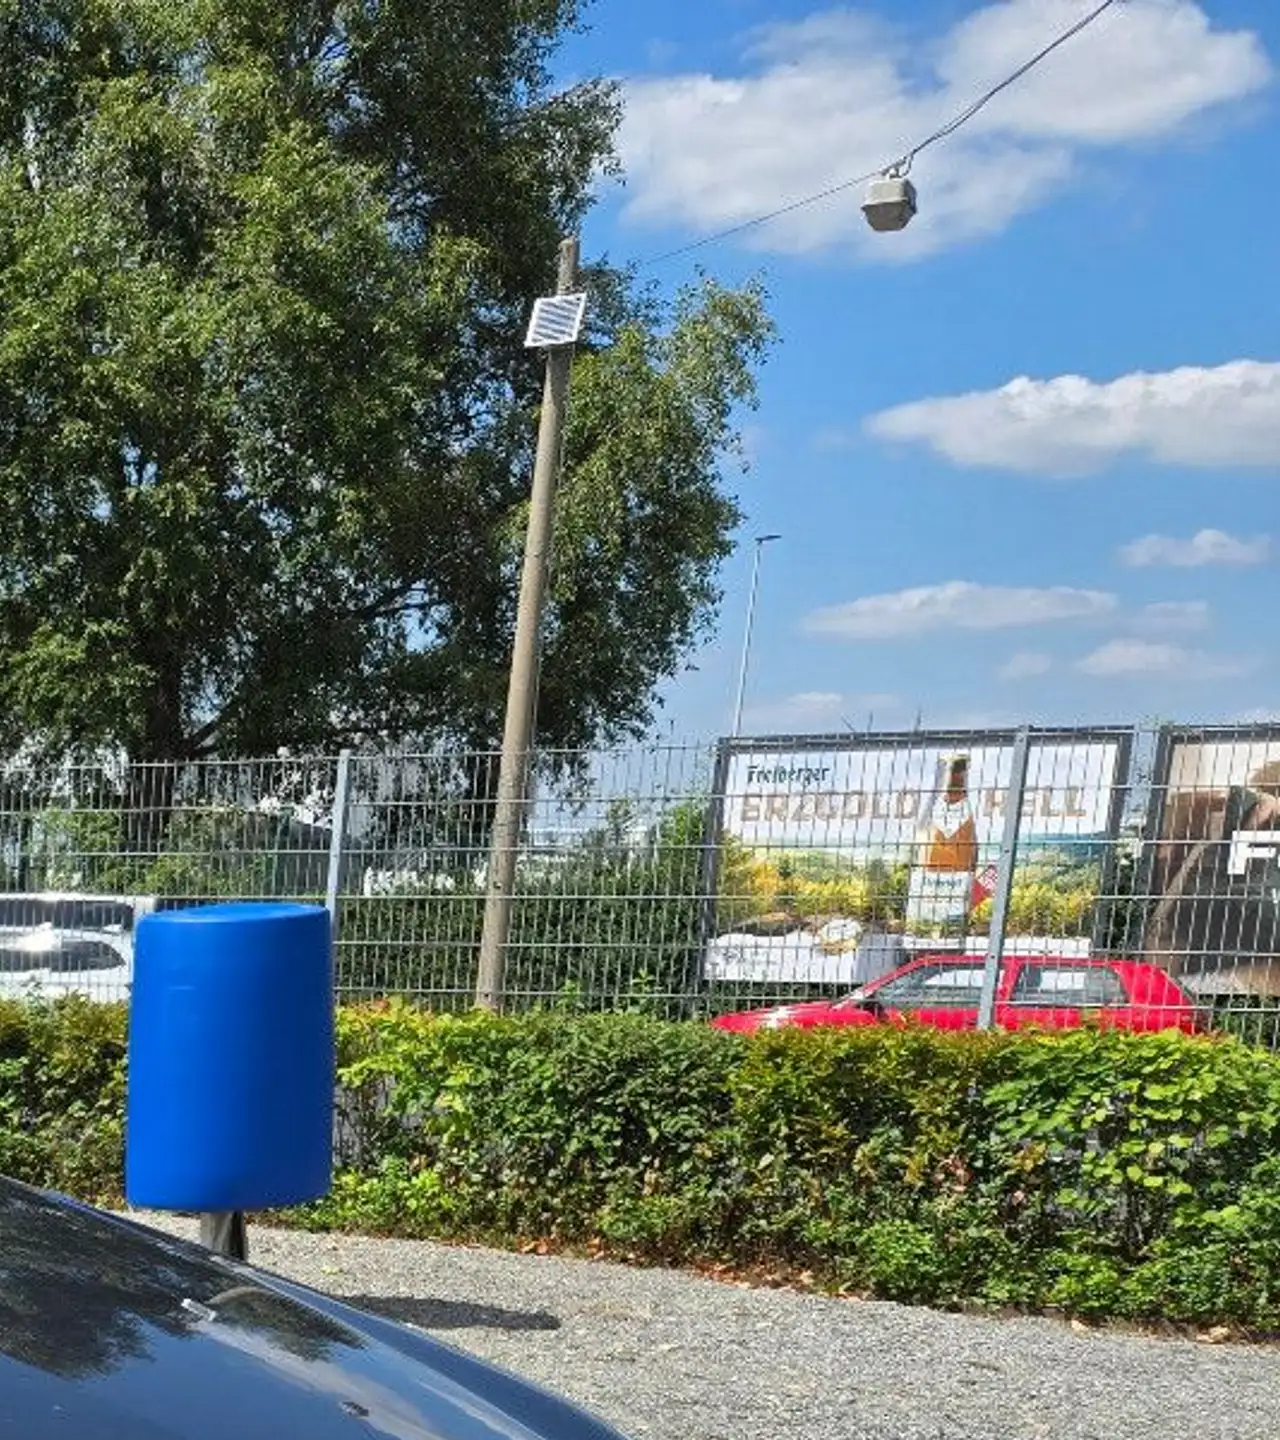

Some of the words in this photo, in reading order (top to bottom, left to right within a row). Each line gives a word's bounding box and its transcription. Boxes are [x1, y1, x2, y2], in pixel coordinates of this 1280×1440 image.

[746, 763, 831, 786] Freiberger
[740, 789, 919, 822] ERZGOLD
[1227, 830, 1280, 875] F
